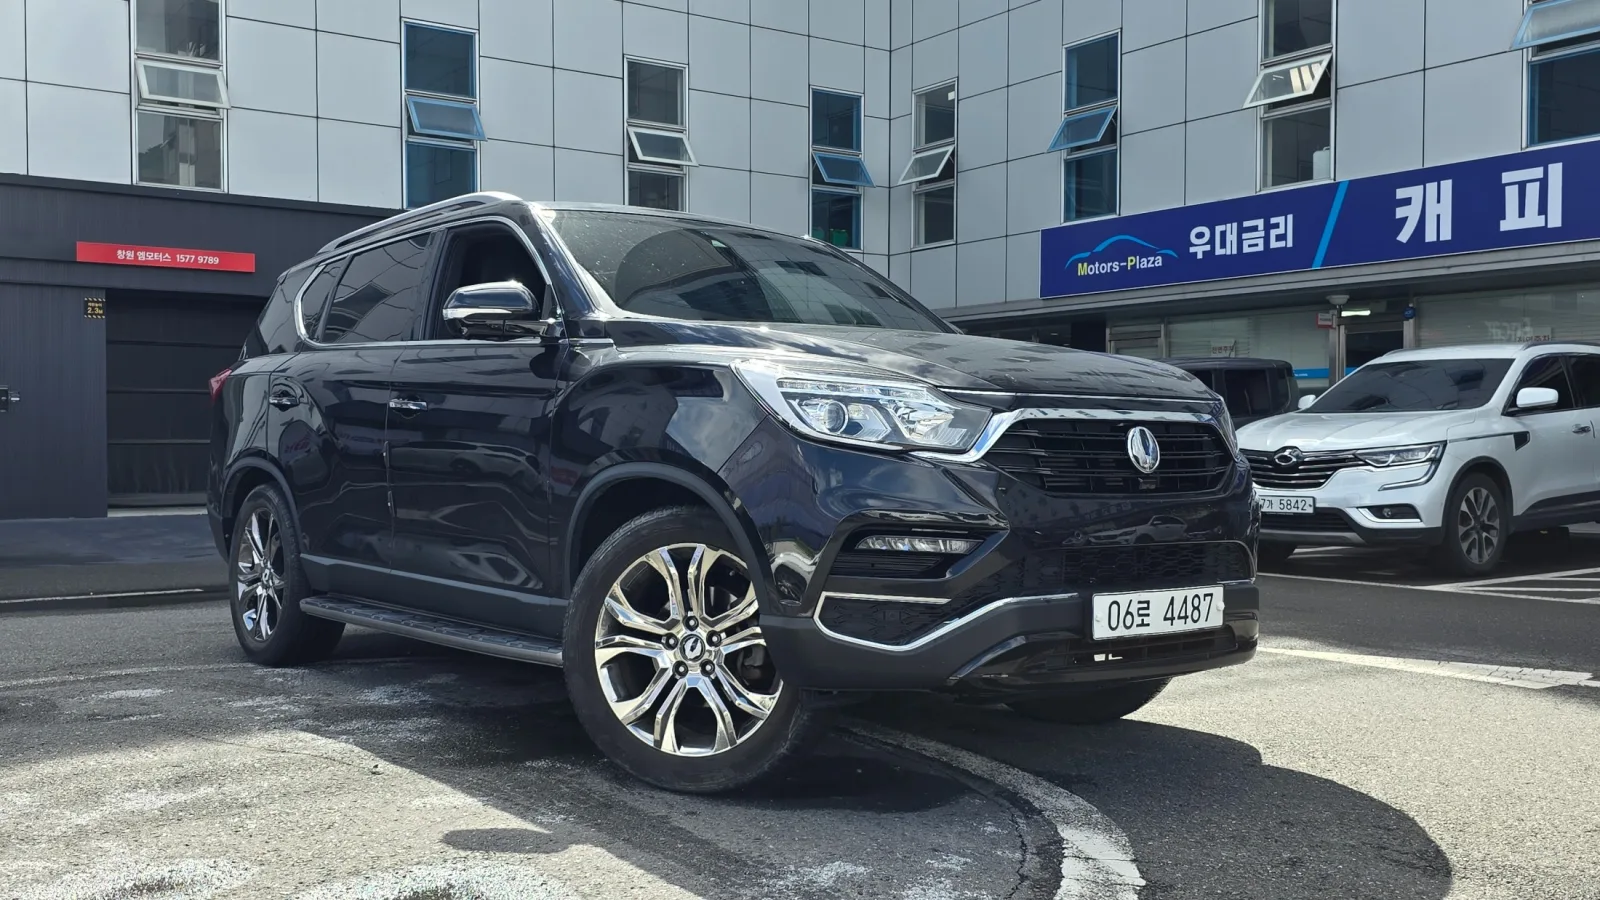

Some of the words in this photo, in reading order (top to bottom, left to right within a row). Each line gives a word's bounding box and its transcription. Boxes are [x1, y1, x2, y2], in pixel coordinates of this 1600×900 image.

[1189, 213, 1294, 260] 우대금리
[116, 249, 135, 261] 창원
[136, 251, 172, 262] 엠모터스
[176, 254, 196, 263] 1577
[197, 255, 220, 265] 9789
[1077, 255, 1163, 277] Motors-Plaza
[1279, 498, 1308, 511] 5842
[1107, 599, 1151, 632] 06로
[1162, 592, 1214, 627] 4487
